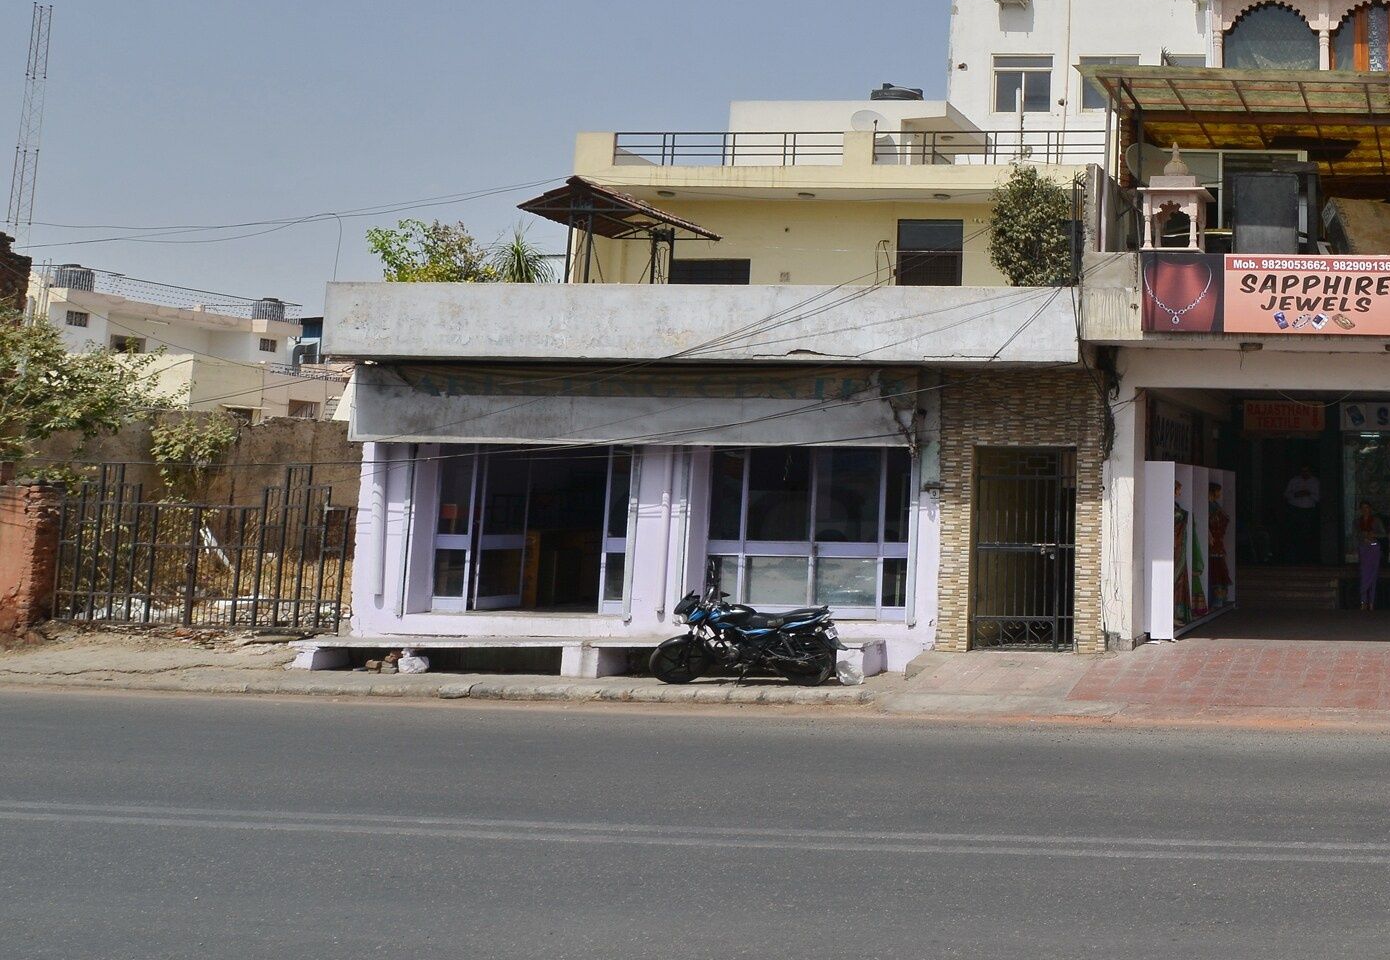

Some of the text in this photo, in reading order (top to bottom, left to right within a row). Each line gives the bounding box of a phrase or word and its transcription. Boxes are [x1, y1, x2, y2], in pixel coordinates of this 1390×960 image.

[1233, 259, 1259, 269] Mob.
[1261, 260, 1330, 271] 9829053662,
[1260, 295, 1372, 313] JEWELS
[1247, 403, 1310, 416] RAJASTHAN
